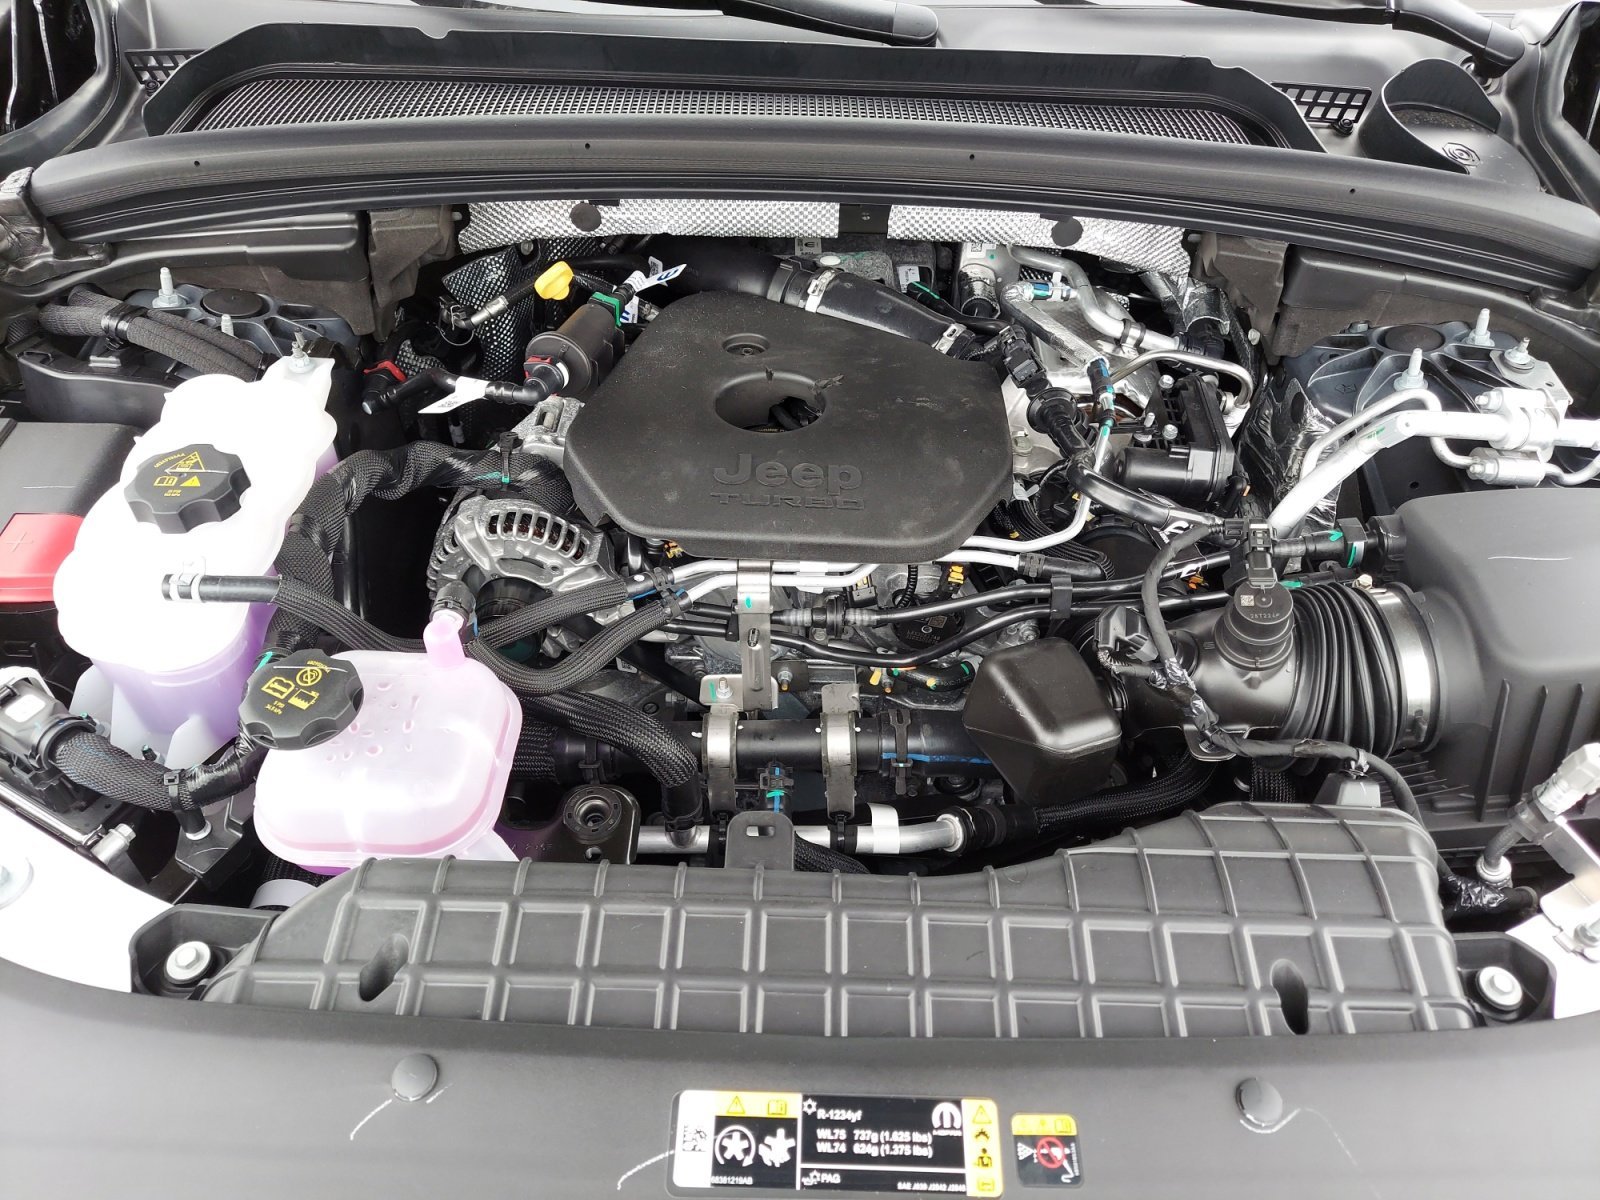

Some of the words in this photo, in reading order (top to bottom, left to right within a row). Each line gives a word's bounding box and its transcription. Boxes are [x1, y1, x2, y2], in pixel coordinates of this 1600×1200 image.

[713, 453, 863, 496] Jeep
[710, 492, 865, 510] TURBO
[817, 1109, 862, 1122] R-1234yf
[816, 1128, 847, 1140] WL75
[853, 1130, 879, 1143] 737g
[912, 1131, 933, 1145] lbs)
[816, 1142, 847, 1153] WL74
[880, 1144, 911, 1157] (1.375
[912, 1144, 933, 1158] lbs)
[820, 1173, 841, 1184] PAG
